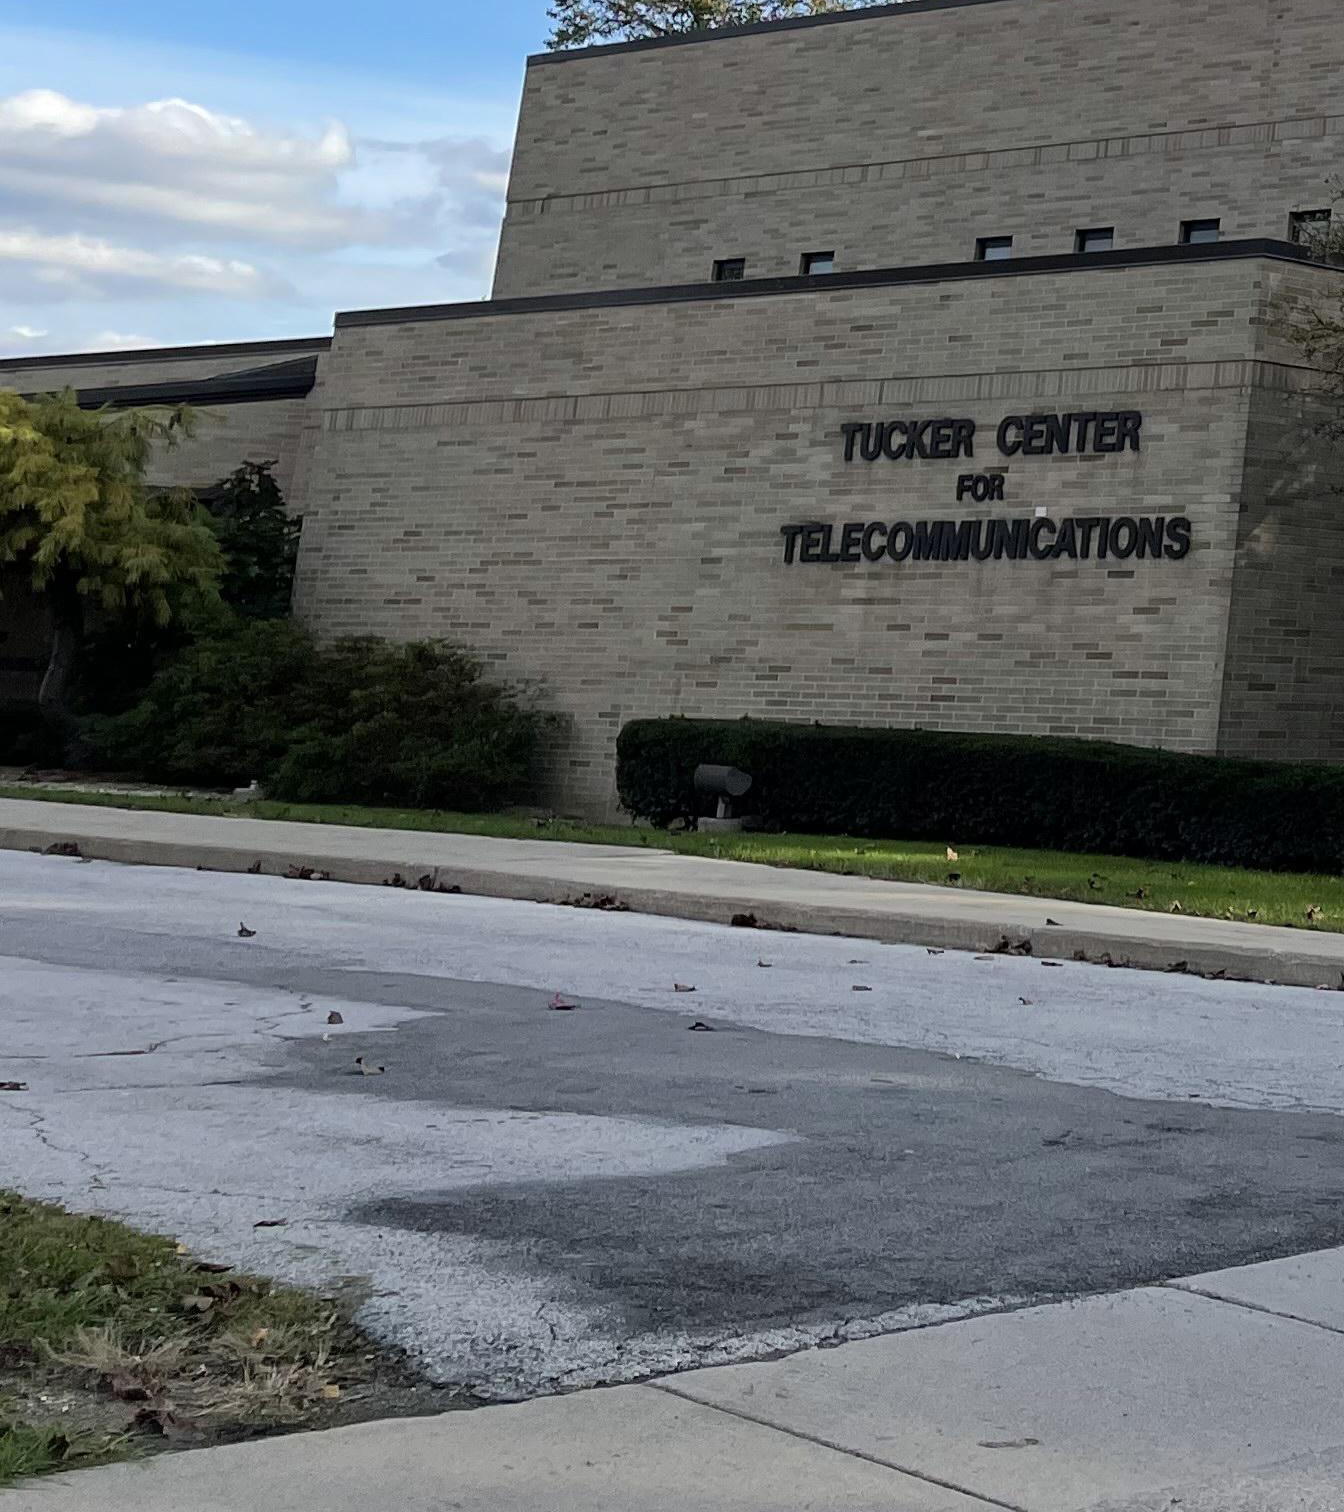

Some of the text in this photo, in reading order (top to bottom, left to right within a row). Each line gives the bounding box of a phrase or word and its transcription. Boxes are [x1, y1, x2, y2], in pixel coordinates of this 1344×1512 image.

[841, 410, 1142, 462] TUCKER CENTER
[956, 474, 1005, 501] FOR
[780, 516, 1191, 565] TELECOMMUNICATIONS
